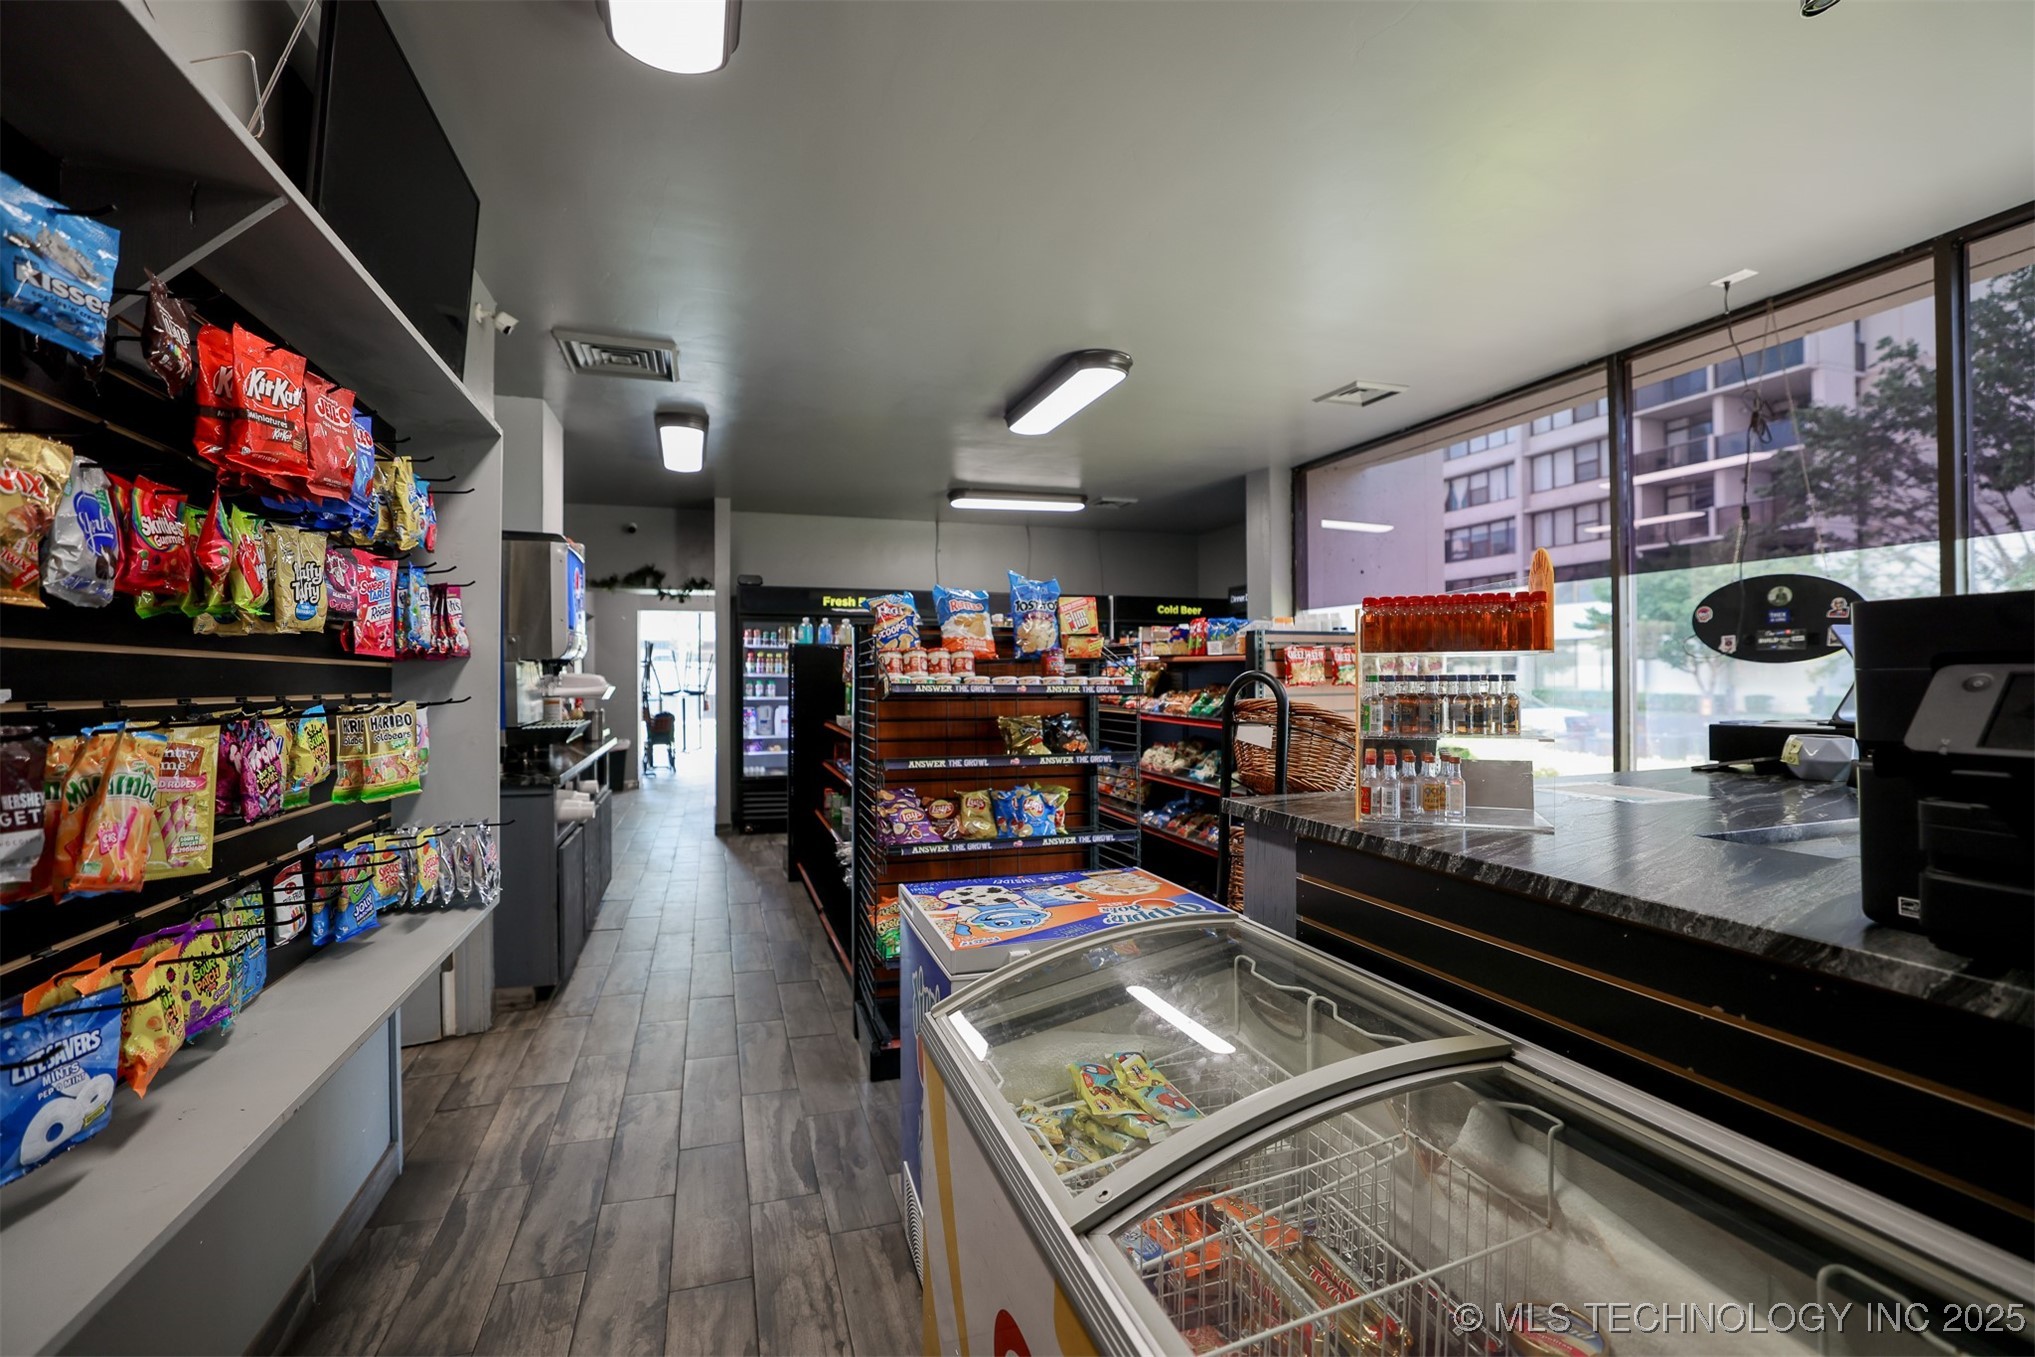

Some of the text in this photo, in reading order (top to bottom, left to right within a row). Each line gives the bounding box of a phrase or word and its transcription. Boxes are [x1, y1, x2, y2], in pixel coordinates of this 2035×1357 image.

[822, 596, 856, 608] Fresh
[949, 599, 984, 612] Ruffles
[1157, 604, 1203, 616] Cold Beer
[915, 684, 953, 692] ANSWER
[1046, 685, 1080, 693] ANSWER
[1082, 685, 1094, 693] THE
[370, 713, 412, 731] HARIBO
[908, 758, 989, 768] ANSWER THE GROWL
[1039, 755, 1113, 765] ANSWER THE GROWL
[1042, 834, 1116, 846] ANSWER THE GROWL
[912, 842, 992, 854] ANSWER THE GROWL
[195, 967, 220, 994] PATCH
[42, 1062, 80, 1087] MINTS
[37, 1087, 55, 1101] PEP
